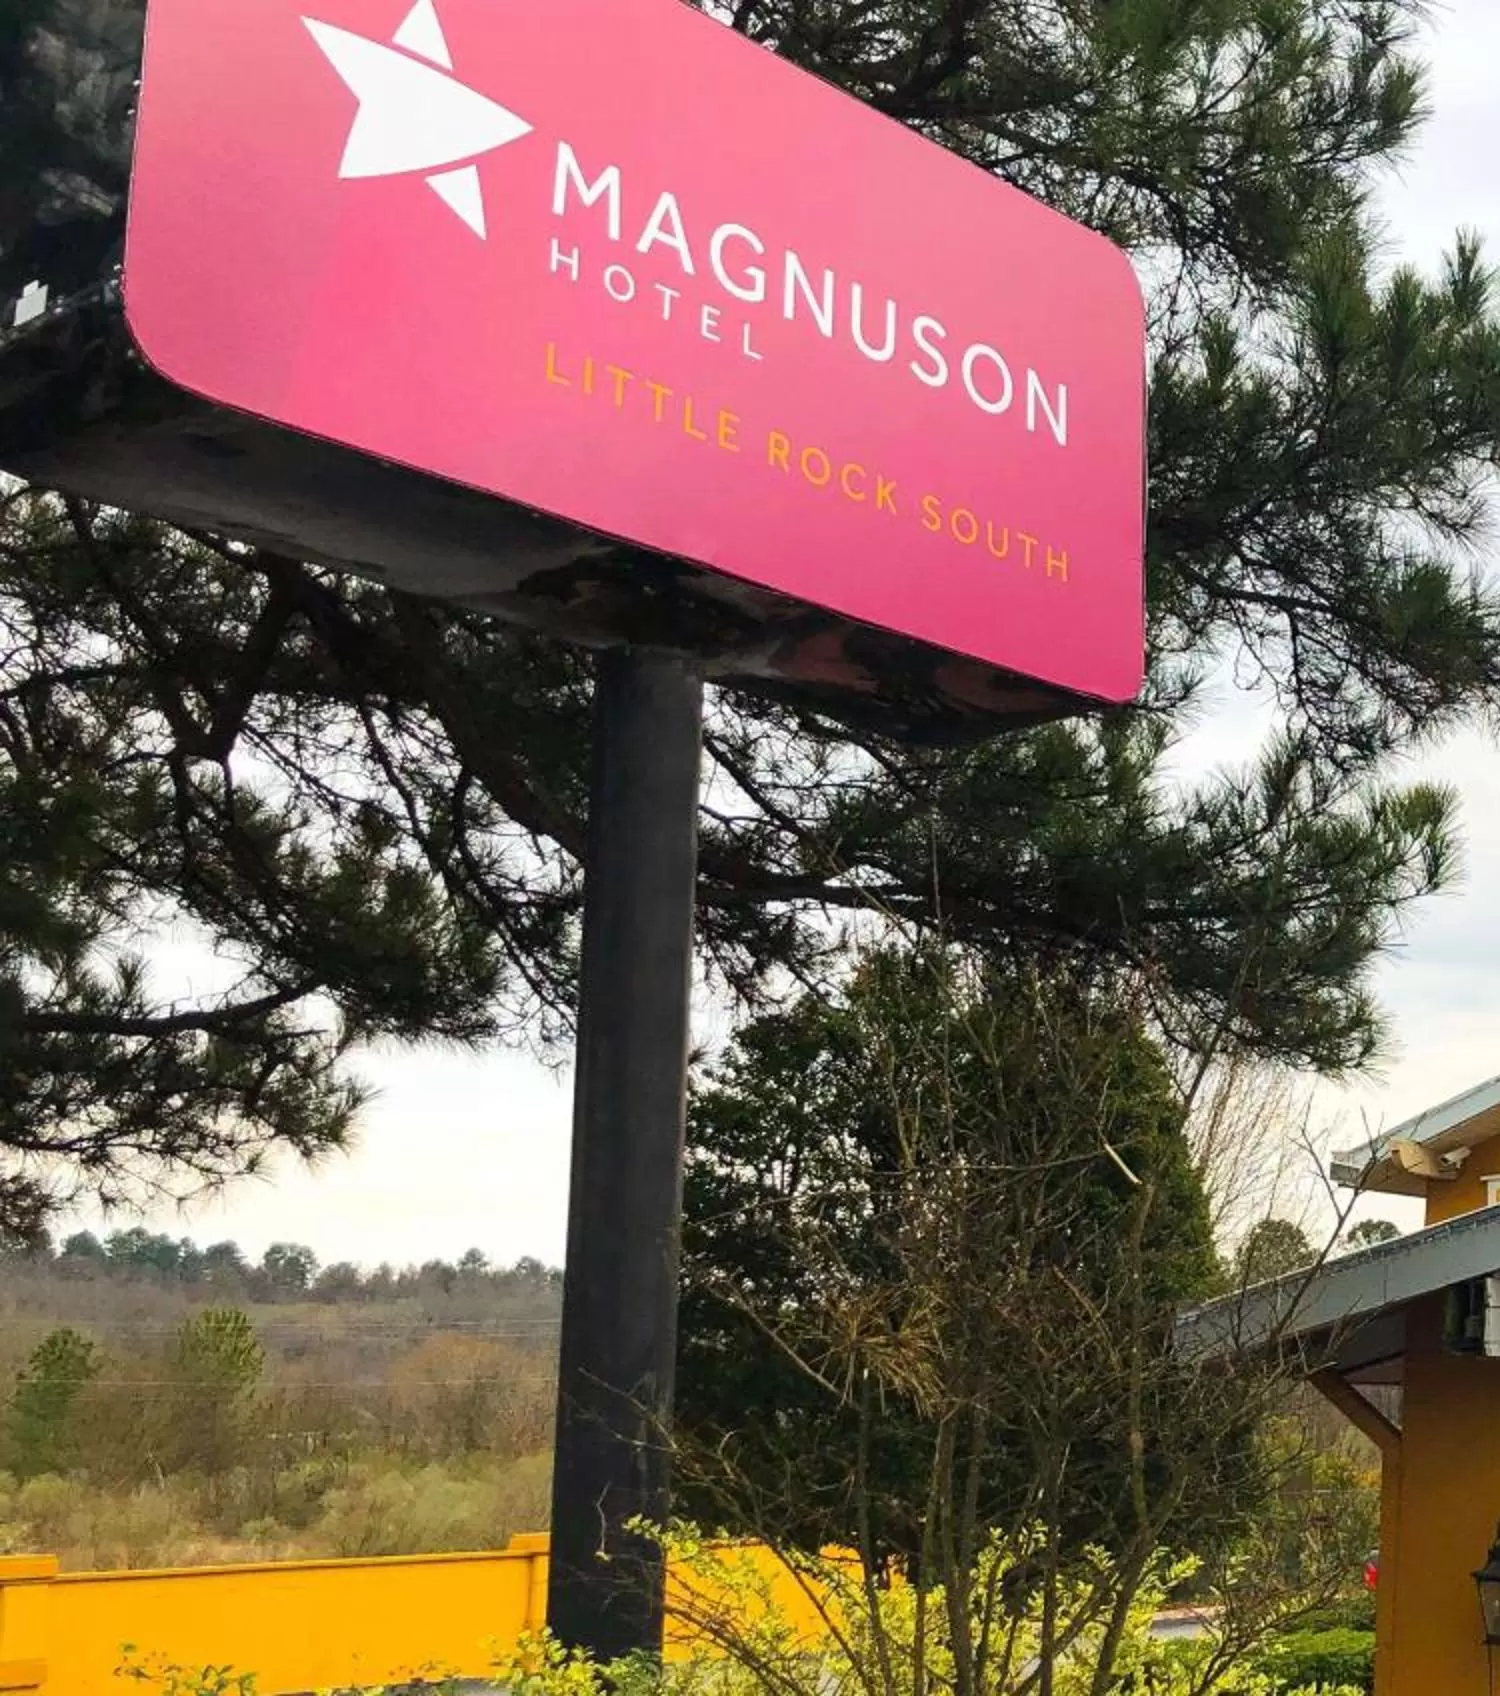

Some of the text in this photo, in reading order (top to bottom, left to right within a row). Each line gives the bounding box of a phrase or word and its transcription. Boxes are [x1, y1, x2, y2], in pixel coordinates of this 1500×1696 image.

[549, 238, 764, 361] HOTEL
[552, 140, 1068, 447] MAGNUSON
[545, 342, 1069, 583] LITTLE ROCK SOUTH
